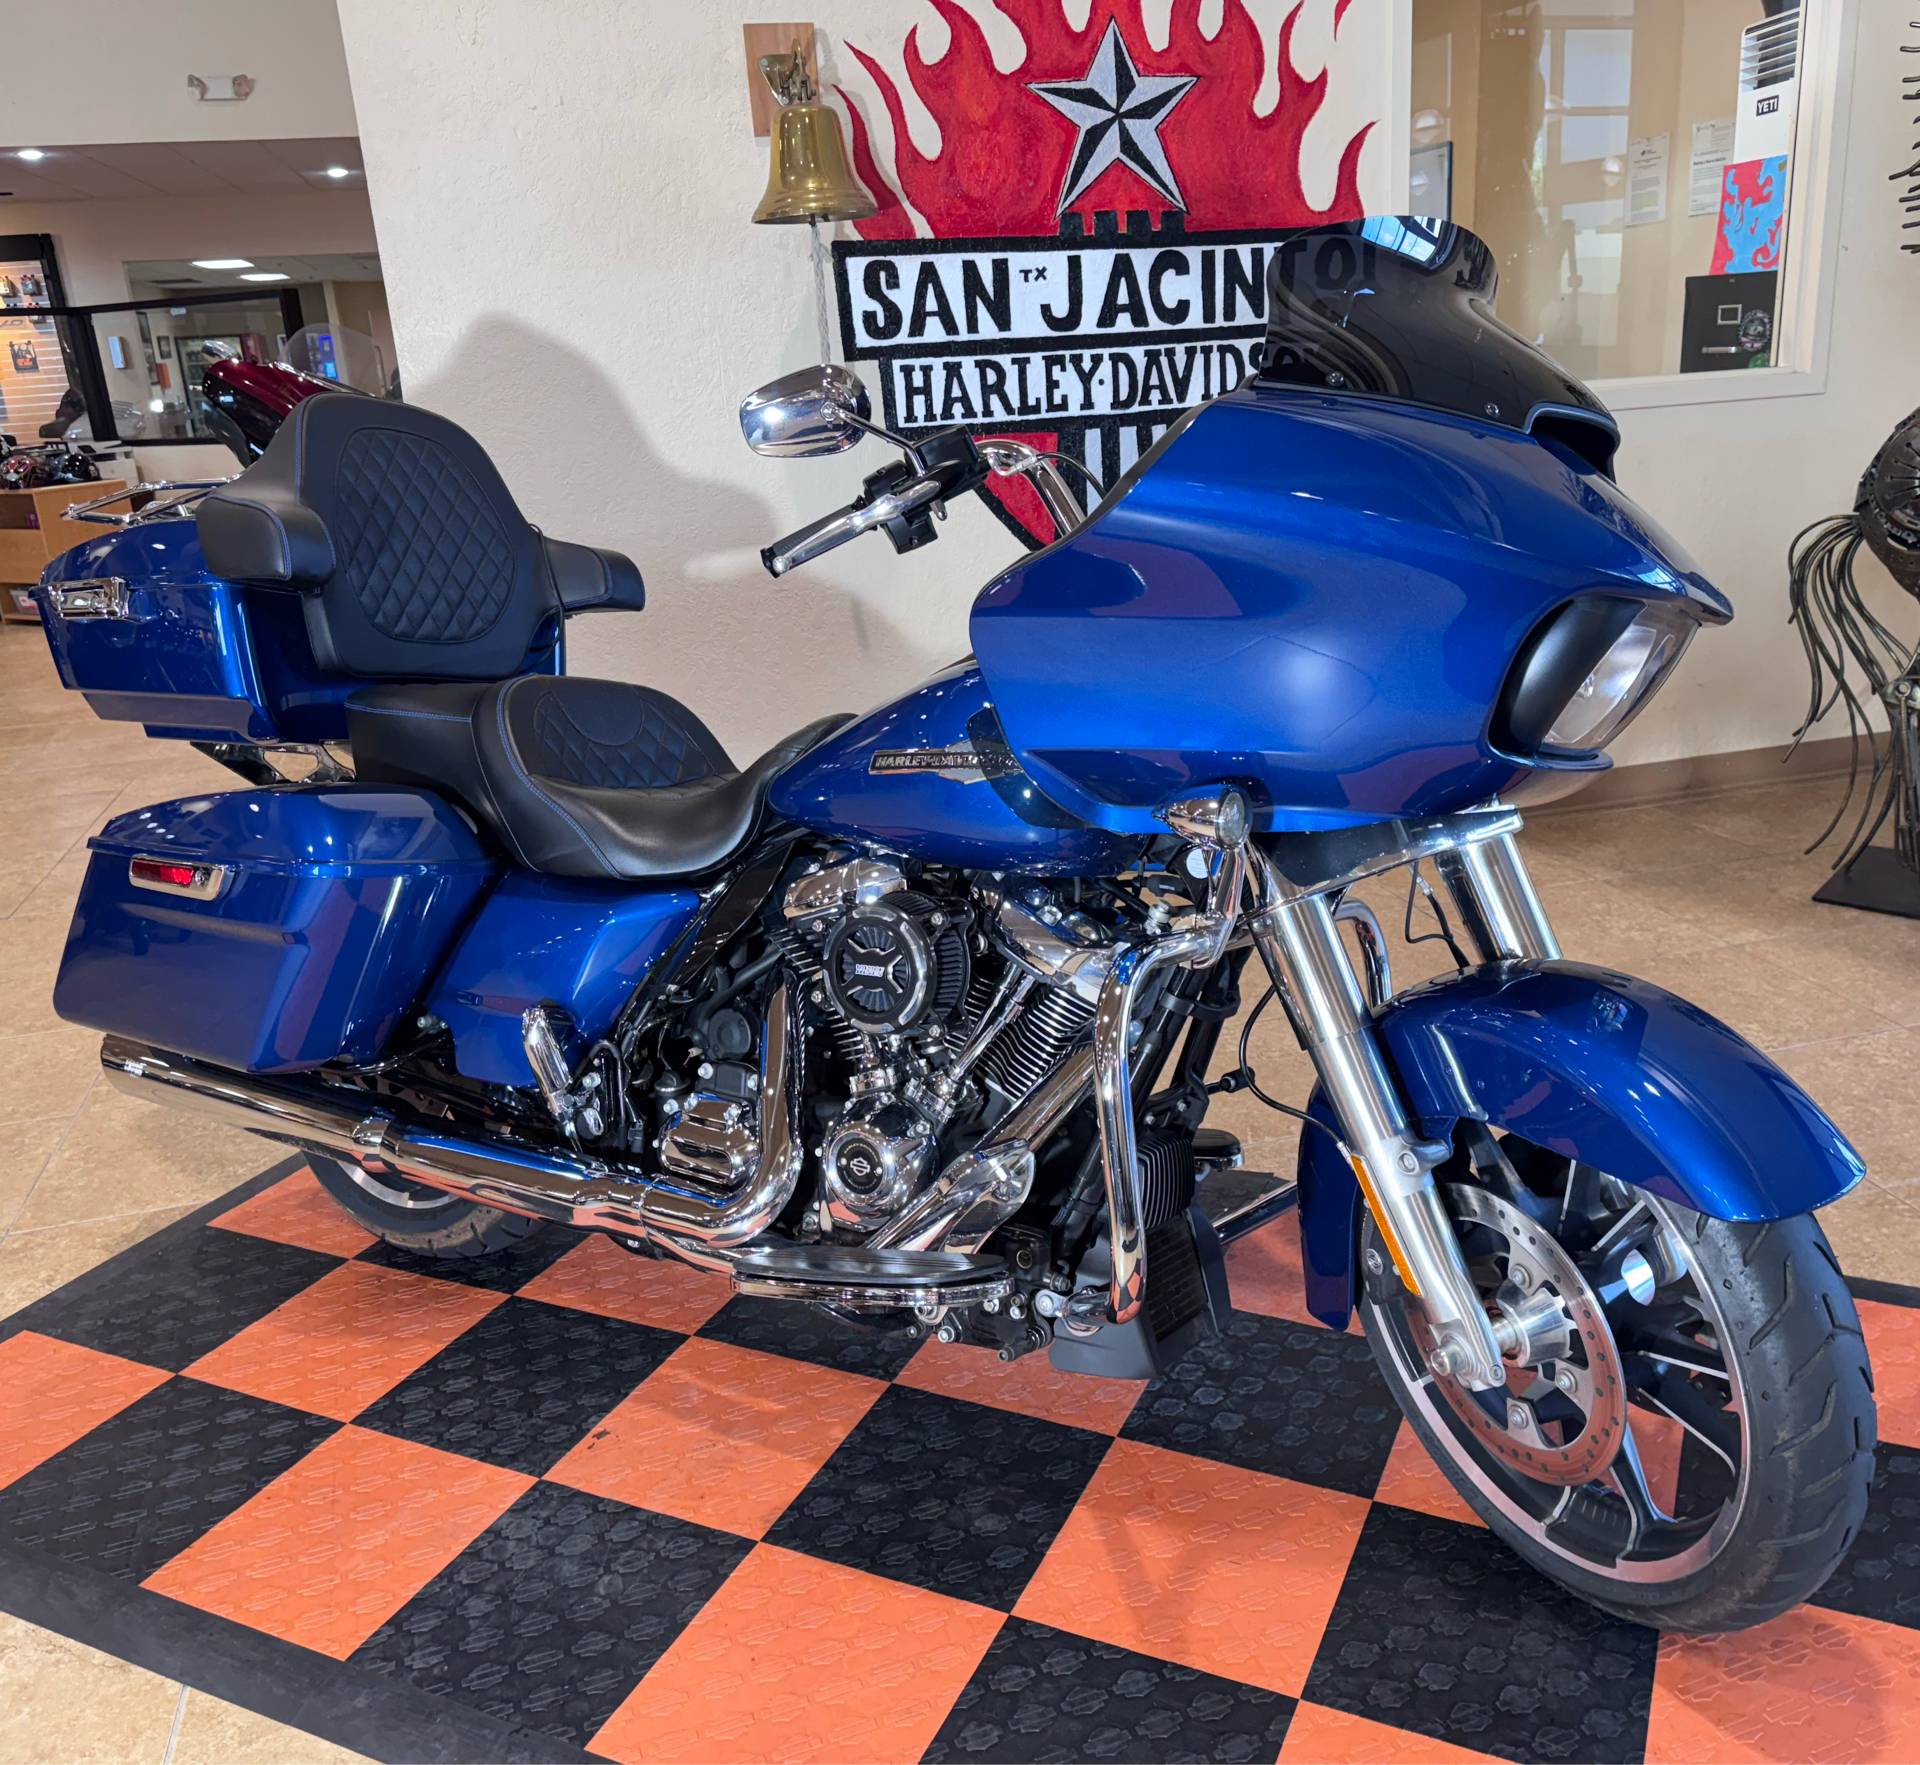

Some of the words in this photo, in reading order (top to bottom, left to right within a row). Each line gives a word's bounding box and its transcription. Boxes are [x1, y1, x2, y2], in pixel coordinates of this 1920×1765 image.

[1757, 98, 1778, 114] YETI
[862, 257, 1012, 340] SAN
[1019, 266, 1047, 283] TX
